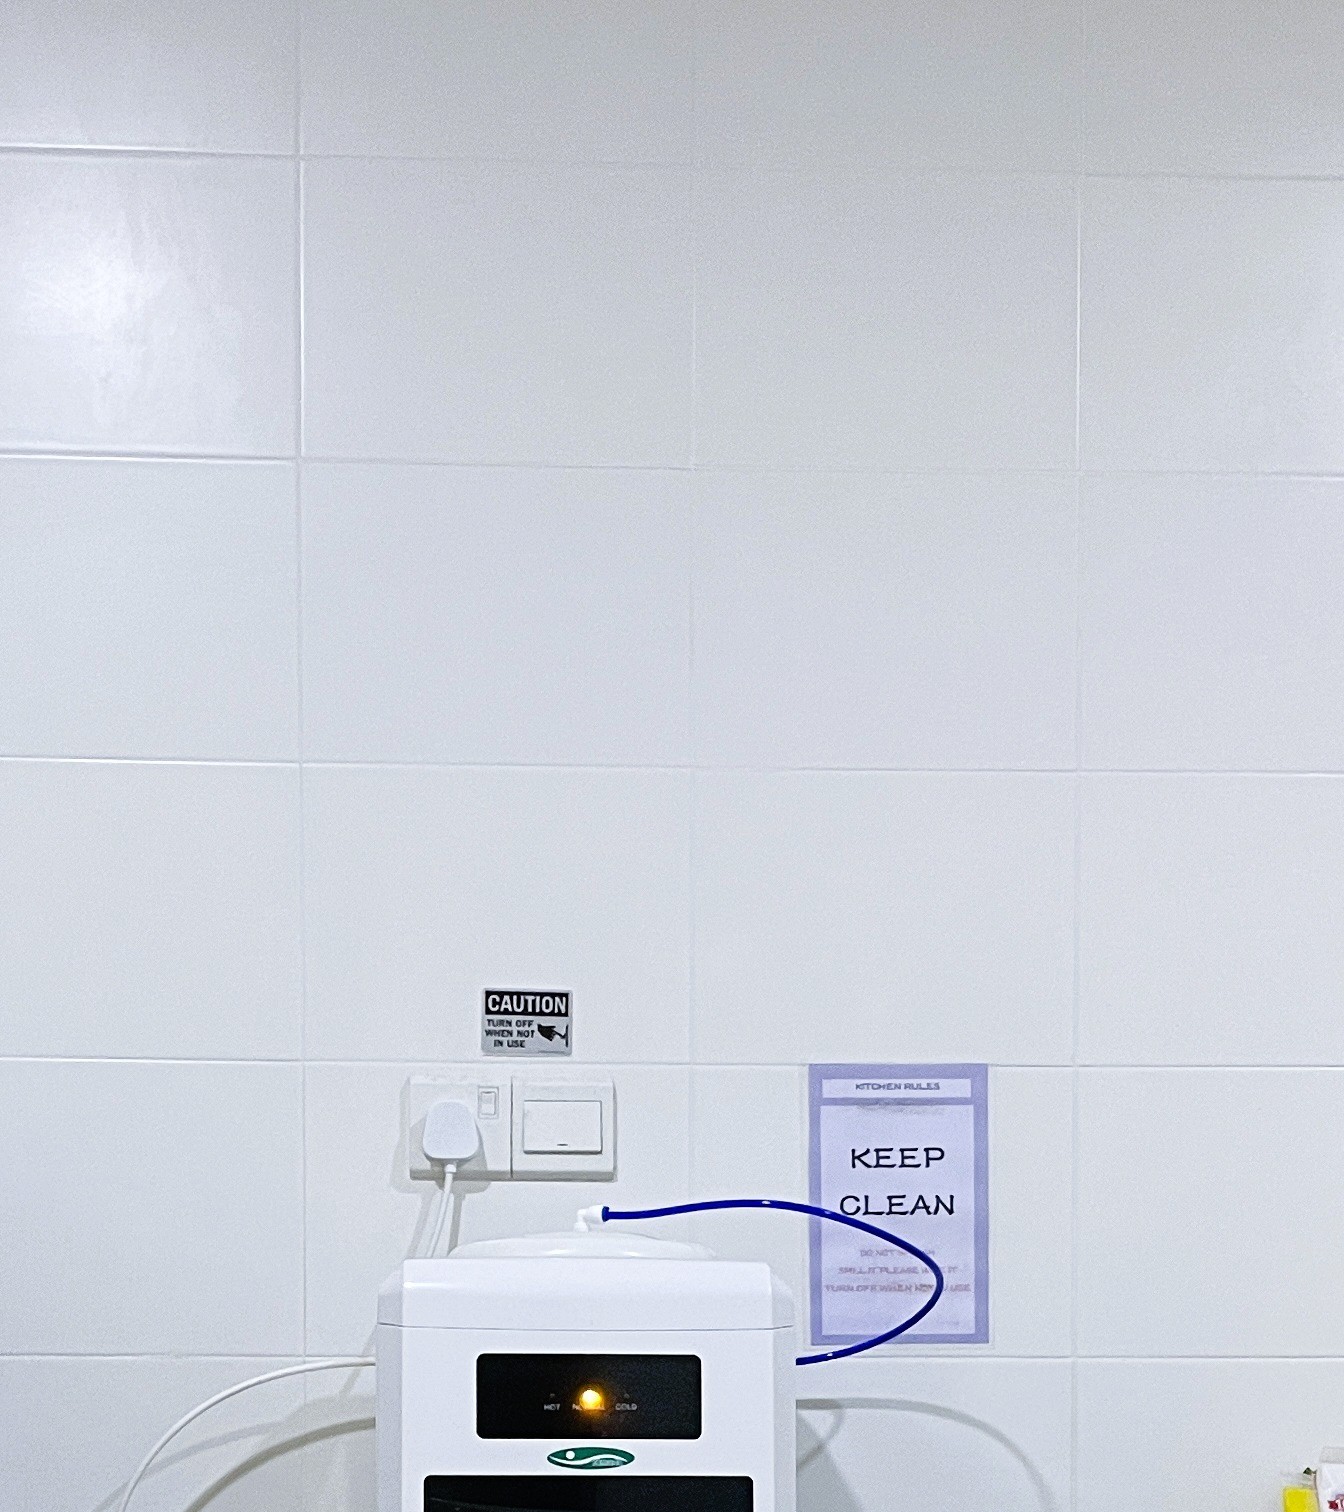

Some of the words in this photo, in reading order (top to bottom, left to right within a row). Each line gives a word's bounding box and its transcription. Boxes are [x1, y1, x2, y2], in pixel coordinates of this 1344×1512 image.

[487, 994, 566, 1014] CAUTION
[487, 1019, 512, 1028] TURN
[515, 1020, 534, 1028] OFF
[485, 1029, 513, 1038] WHEN
[516, 1030, 535, 1038] NOT
[506, 1040, 525, 1048] USE
[903, 1082, 940, 1090] RULES
[851, 1147, 945, 1168] KEEP
[839, 1194, 955, 1216] CLEAN
